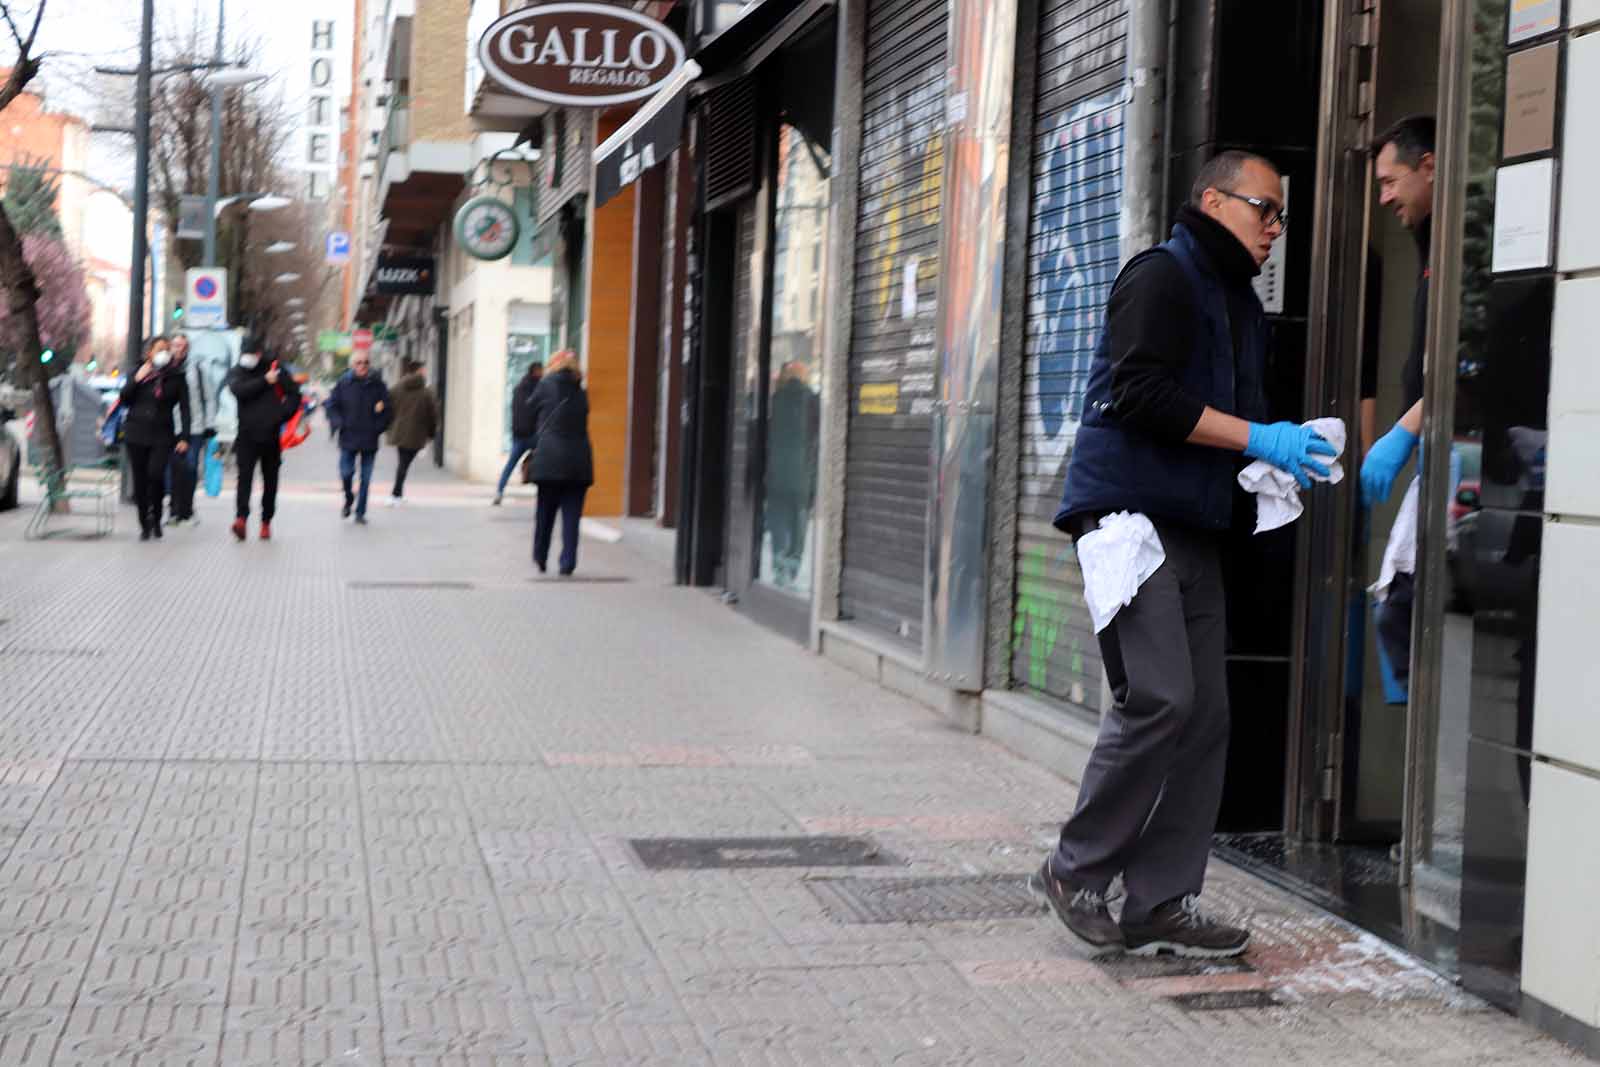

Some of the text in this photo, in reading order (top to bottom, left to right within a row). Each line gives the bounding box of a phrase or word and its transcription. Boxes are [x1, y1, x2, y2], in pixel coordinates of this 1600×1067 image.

[500, 24, 667, 70] GALLO
[569, 68, 650, 85] REGALOS
[309, 19, 334, 200] HOTEL
